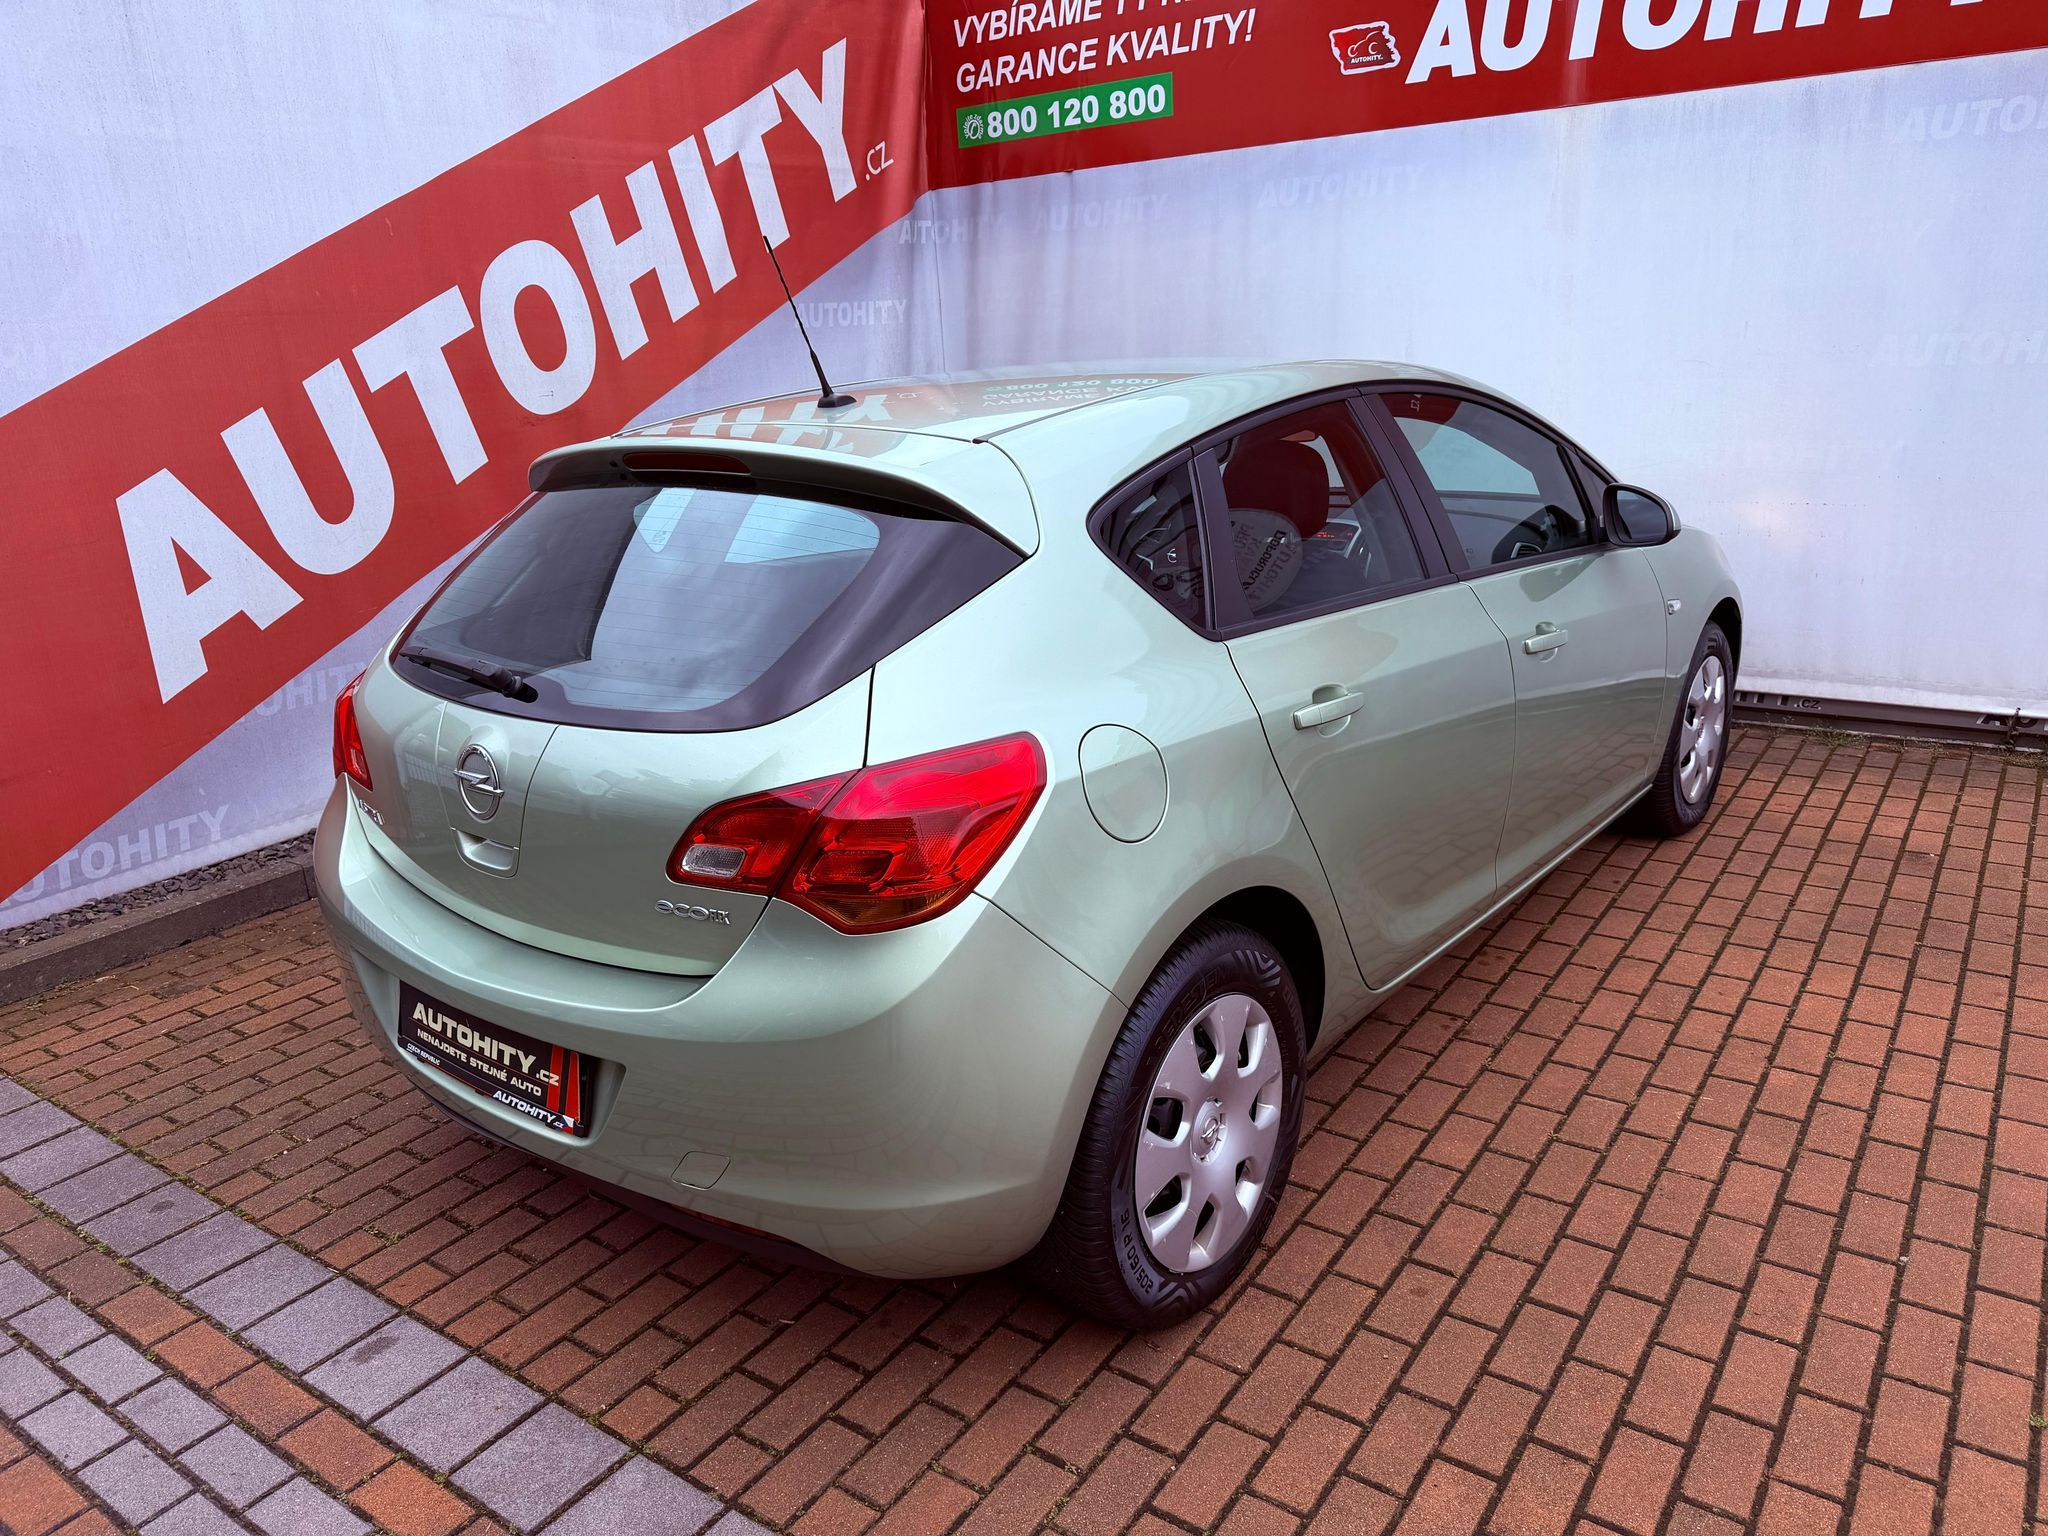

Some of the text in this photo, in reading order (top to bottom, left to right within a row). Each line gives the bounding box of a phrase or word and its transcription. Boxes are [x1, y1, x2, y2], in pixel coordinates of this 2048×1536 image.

[956, 8, 1256, 93] GARANCE KVALITY!
[987, 84, 1166, 138] 800 120 800
[417, 1028, 542, 1097] NENAJDETE STEJNÉ AUTO
